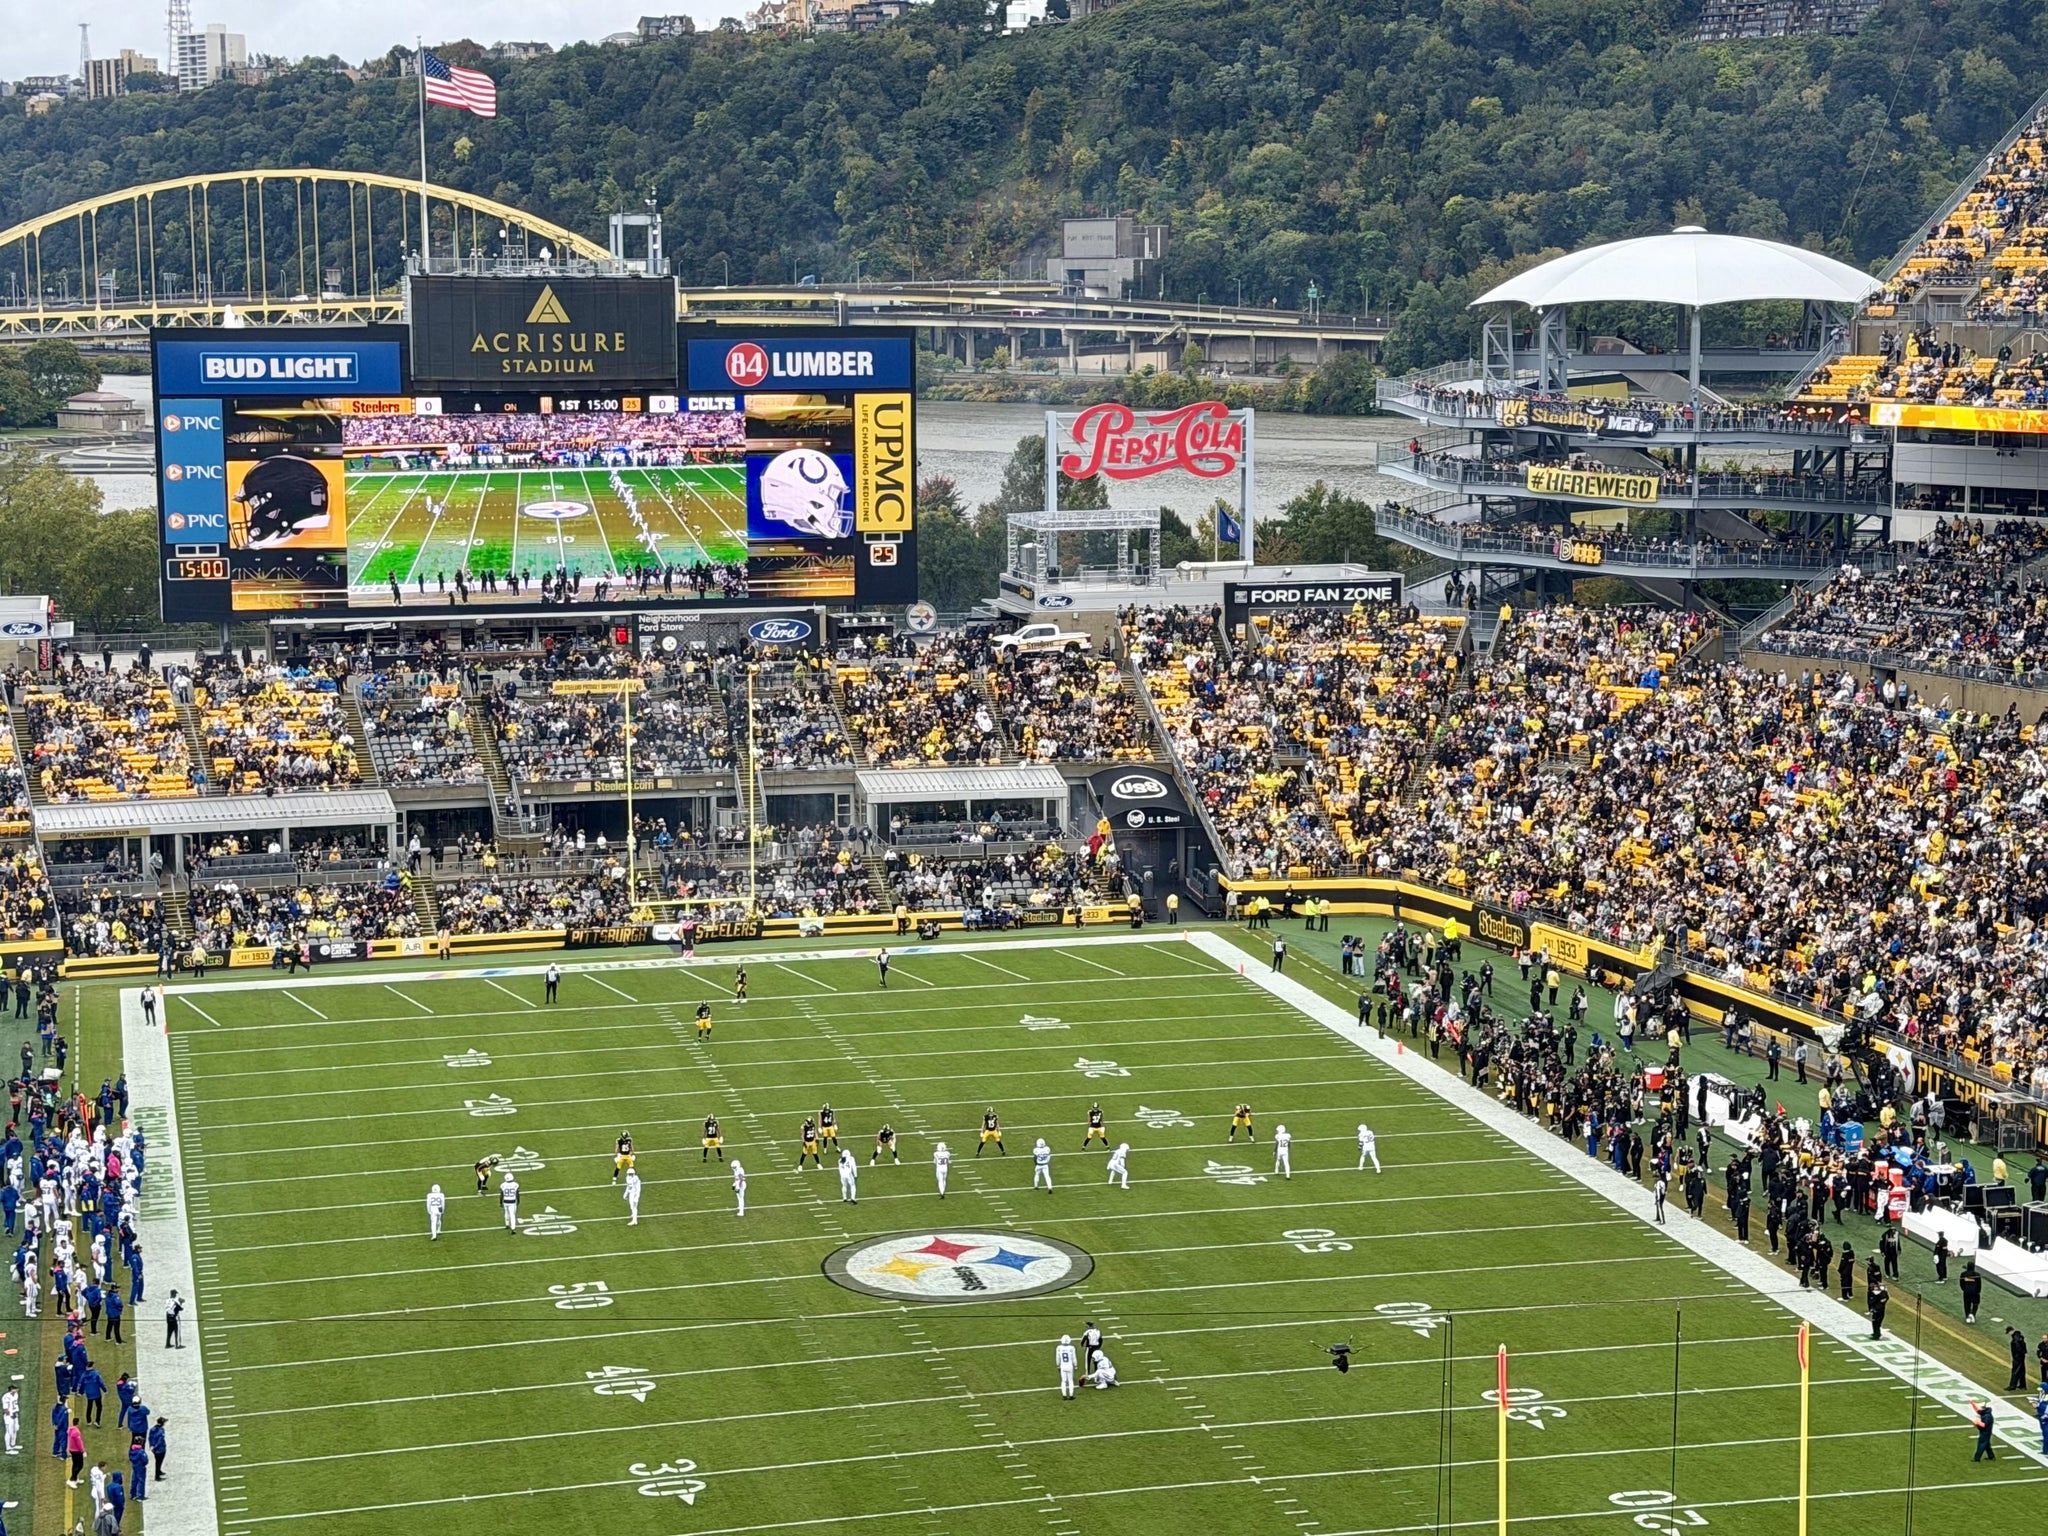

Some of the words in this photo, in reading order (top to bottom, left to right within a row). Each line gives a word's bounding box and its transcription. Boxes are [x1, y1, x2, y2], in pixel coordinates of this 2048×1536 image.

[470, 332, 626, 353] ACRISURE
[206, 358, 266, 379] BUD
[270, 357, 351, 378] LIGHT
[502, 359, 594, 374] STADIUM
[729, 352, 764, 379] 84
[772, 351, 874, 378] LUMBER
[352, 400, 400, 412] Steelers
[425, 402, 433, 411] 0
[504, 402, 517, 412] ON
[559, 399, 580, 410] 1ST
[588, 399, 619, 410] 15:00
[626, 399, 637, 409] 25
[658, 398, 666, 409] 0
[688, 397, 736, 410] COLTS
[1503, 400, 1528, 415] WE
[184, 416, 221, 431] PNC
[1608, 415, 1655, 433] Mafia
[874, 400, 905, 524] UPMC
[186, 464, 223, 479] PNC
[1531, 470, 1652, 500] #HEREWEGO
[188, 513, 224, 528] PNC
[873, 546, 894, 563] 25
[178, 560, 225, 578] 15:00
[1251, 589, 1301, 604] FORD
[1304, 588, 1340, 602] FAN
[1343, 586, 1393, 601] ZONE
[638, 614, 700, 624] Neighborhood
[638, 624, 659, 632] Ford
[661, 623, 684, 631] Store
[9, 623, 35, 634] Ford
[760, 621, 800, 640] Ford
[594, 780, 655, 792] Steeler.com
[1165, 815, 1180, 823] Steel
[1022, 911, 1058, 923] Steelers
[571, 926, 648, 944] PITTSBURGH
[695, 921, 758, 939] STEELERS
[1478, 910, 1524, 947] Steelers
[252, 952, 270, 961] 1933
[1556, 938, 1577, 960] 1933
[183, 954, 224, 968] Stlers
[1073, 1060, 1132, 1078] 20
[464, 1097, 517, 1117] 20
[133, 1105, 172, 1149] CANCER
[1134, 1109, 1196, 1129] 30
[1203, 1164, 1269, 1186] 40
[430, 1197, 442, 1206] 29
[517, 1212, 578, 1236] 40
[1282, 1228, 1354, 1253] 50
[547, 1281, 614, 1310] 50
[1374, 1302, 1451, 1329] 40
[1061, 1352, 1069, 1363] 8
[585, 1365, 657, 1396] 40
[1481, 1388, 1567, 1420] 30
[629, 1458, 707, 1498] 30
[1608, 1489, 1710, 1530] 20
